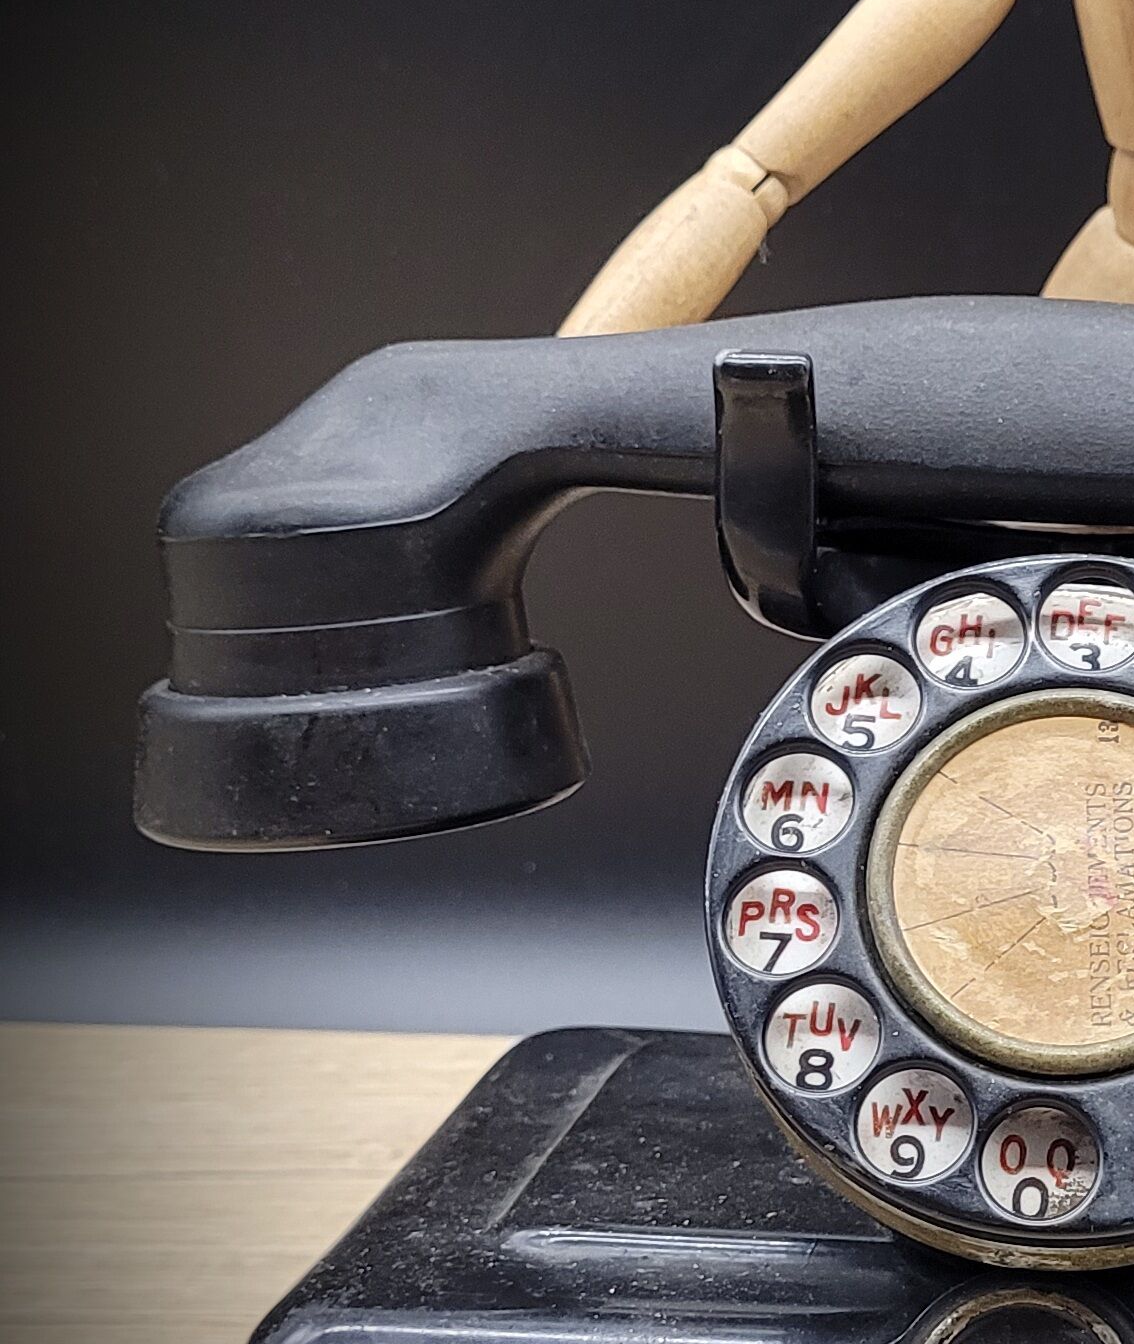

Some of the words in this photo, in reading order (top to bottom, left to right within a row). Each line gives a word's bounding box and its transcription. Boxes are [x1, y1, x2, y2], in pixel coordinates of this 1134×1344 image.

[929, 613, 997, 659] GHI
[1069, 642, 1101, 670] 3
[945, 655, 979, 686] 4
[825, 673, 902, 721] JKL
[841, 713, 876, 750] 5
[771, 813, 804, 852] 6
[738, 887, 820, 942] PRS
[759, 931, 793, 973] 7
[782, 1001, 861, 1052] TUV
[796, 1048, 834, 1091] 8
[871, 1087, 955, 1143] WXY
[890, 1134, 926, 1179] 9
